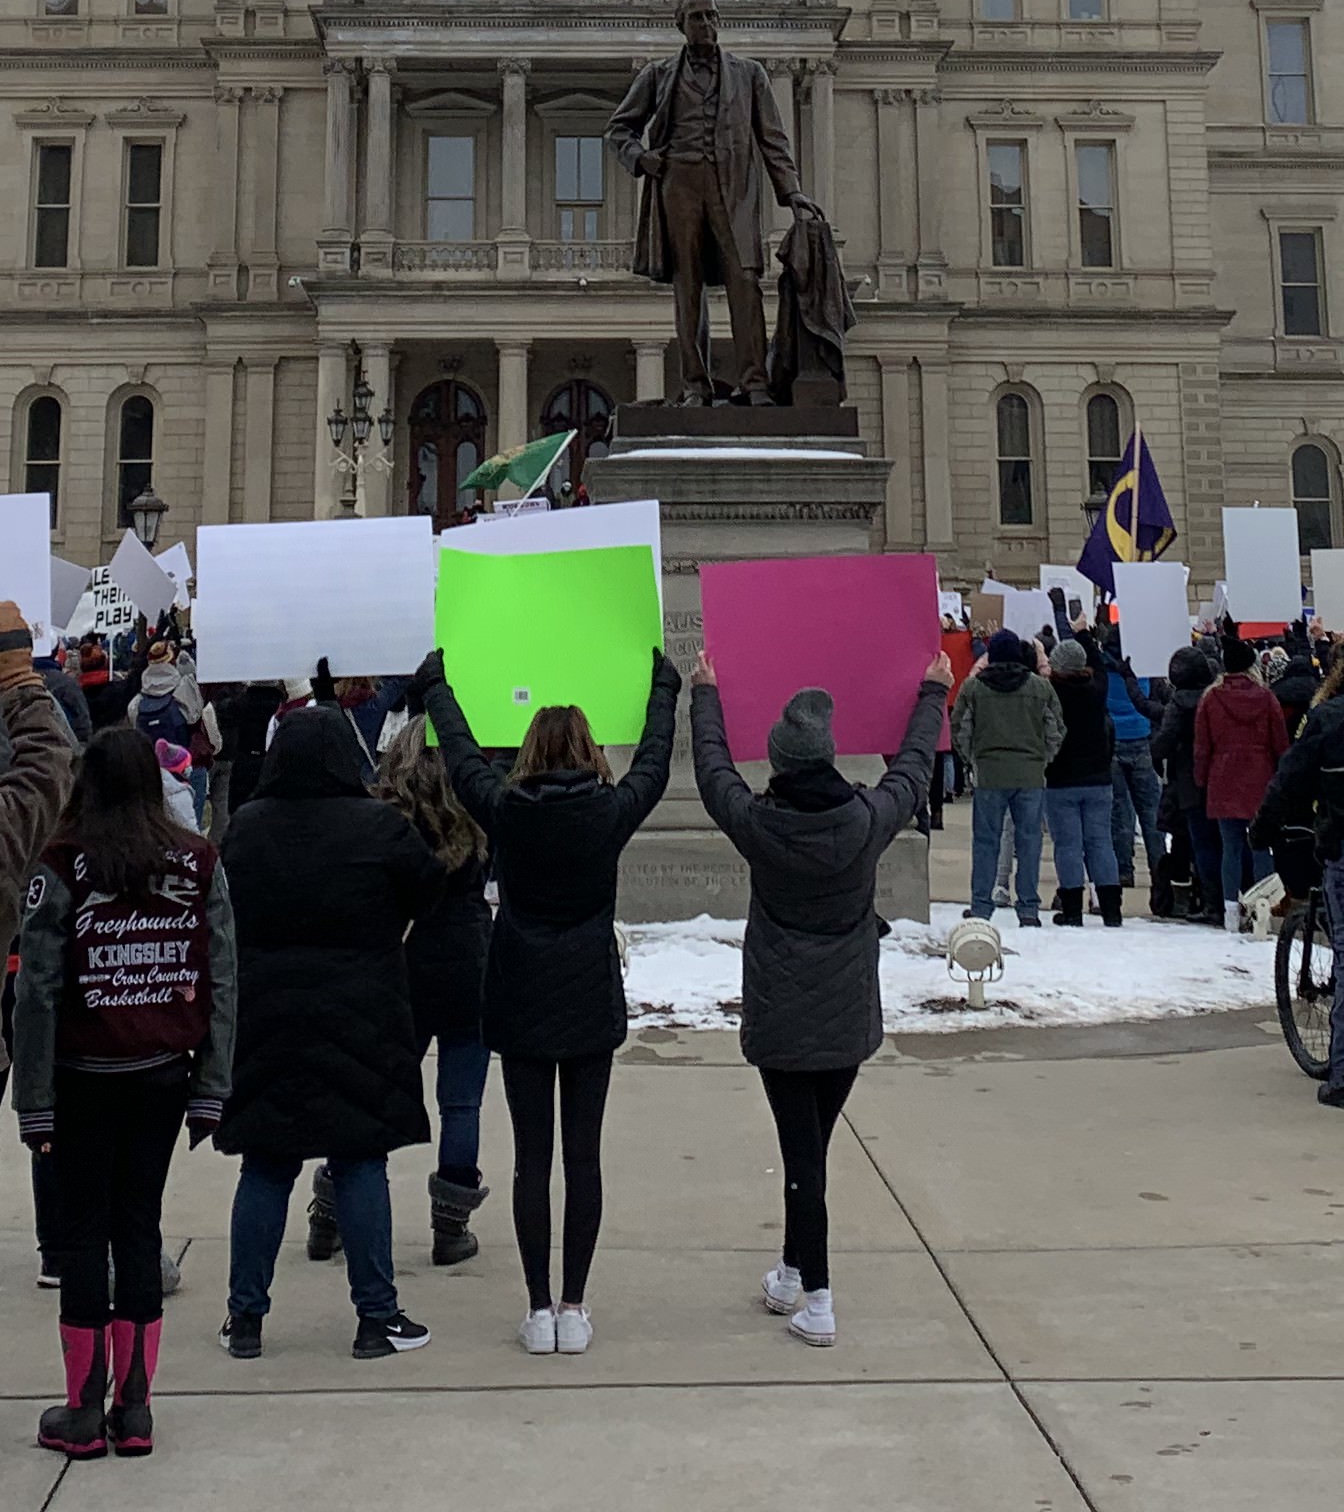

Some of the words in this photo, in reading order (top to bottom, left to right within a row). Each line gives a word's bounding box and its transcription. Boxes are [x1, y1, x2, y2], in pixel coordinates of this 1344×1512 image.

[94, 568, 110, 587] LE
[76, 909, 199, 939] Greyhounds
[88, 941, 191, 969] KINGSLEY
[112, 968, 146, 986] Cross
[147, 965, 200, 985] Country
[84, 987, 174, 1009] Basketball
